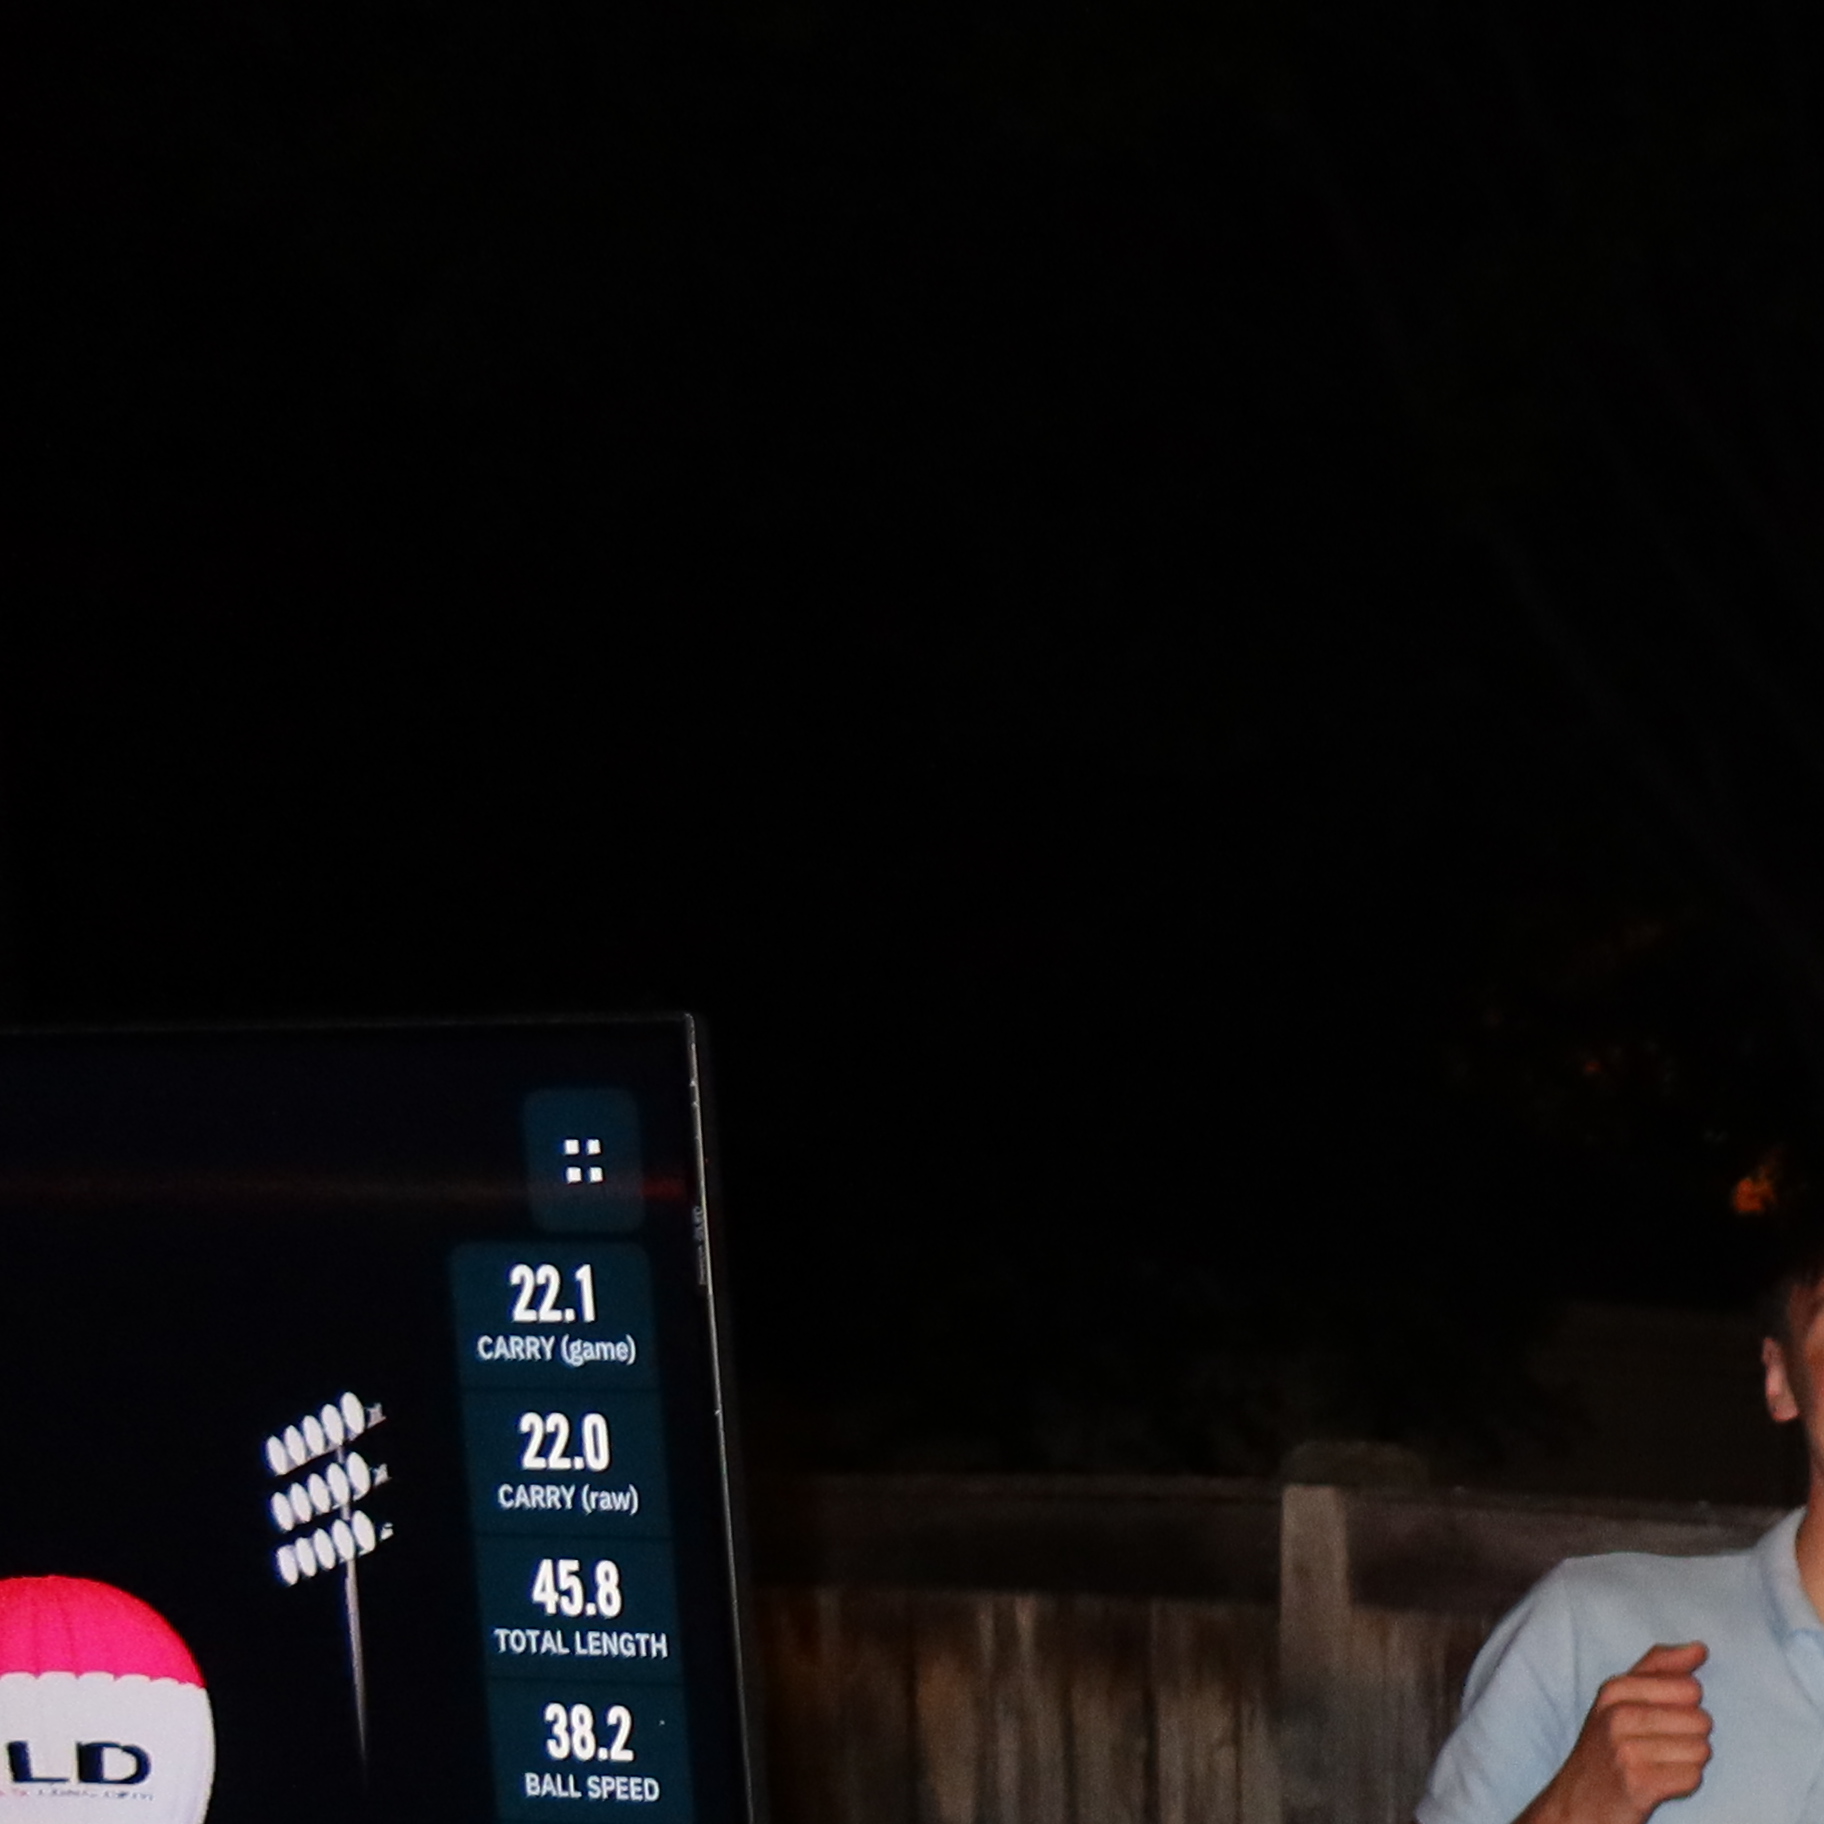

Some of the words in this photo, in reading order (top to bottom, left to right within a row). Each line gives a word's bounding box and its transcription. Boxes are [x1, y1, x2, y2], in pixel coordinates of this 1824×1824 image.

[510, 1263, 596, 1324] 22.1
[477, 1335, 554, 1361] CARRY
[561, 1334, 636, 1367] (game)
[519, 1412, 610, 1471] 22.0
[498, 1484, 575, 1509] CARRY
[582, 1484, 638, 1515] (raw)
[532, 1558, 622, 1619] 45.8
[494, 1628, 569, 1656] TOTAL
[575, 1631, 668, 1659] LENGTH
[544, 1703, 634, 1762] 38.2
[525, 1772, 581, 1799] BALL
[587, 1775, 660, 1802] SPEED
